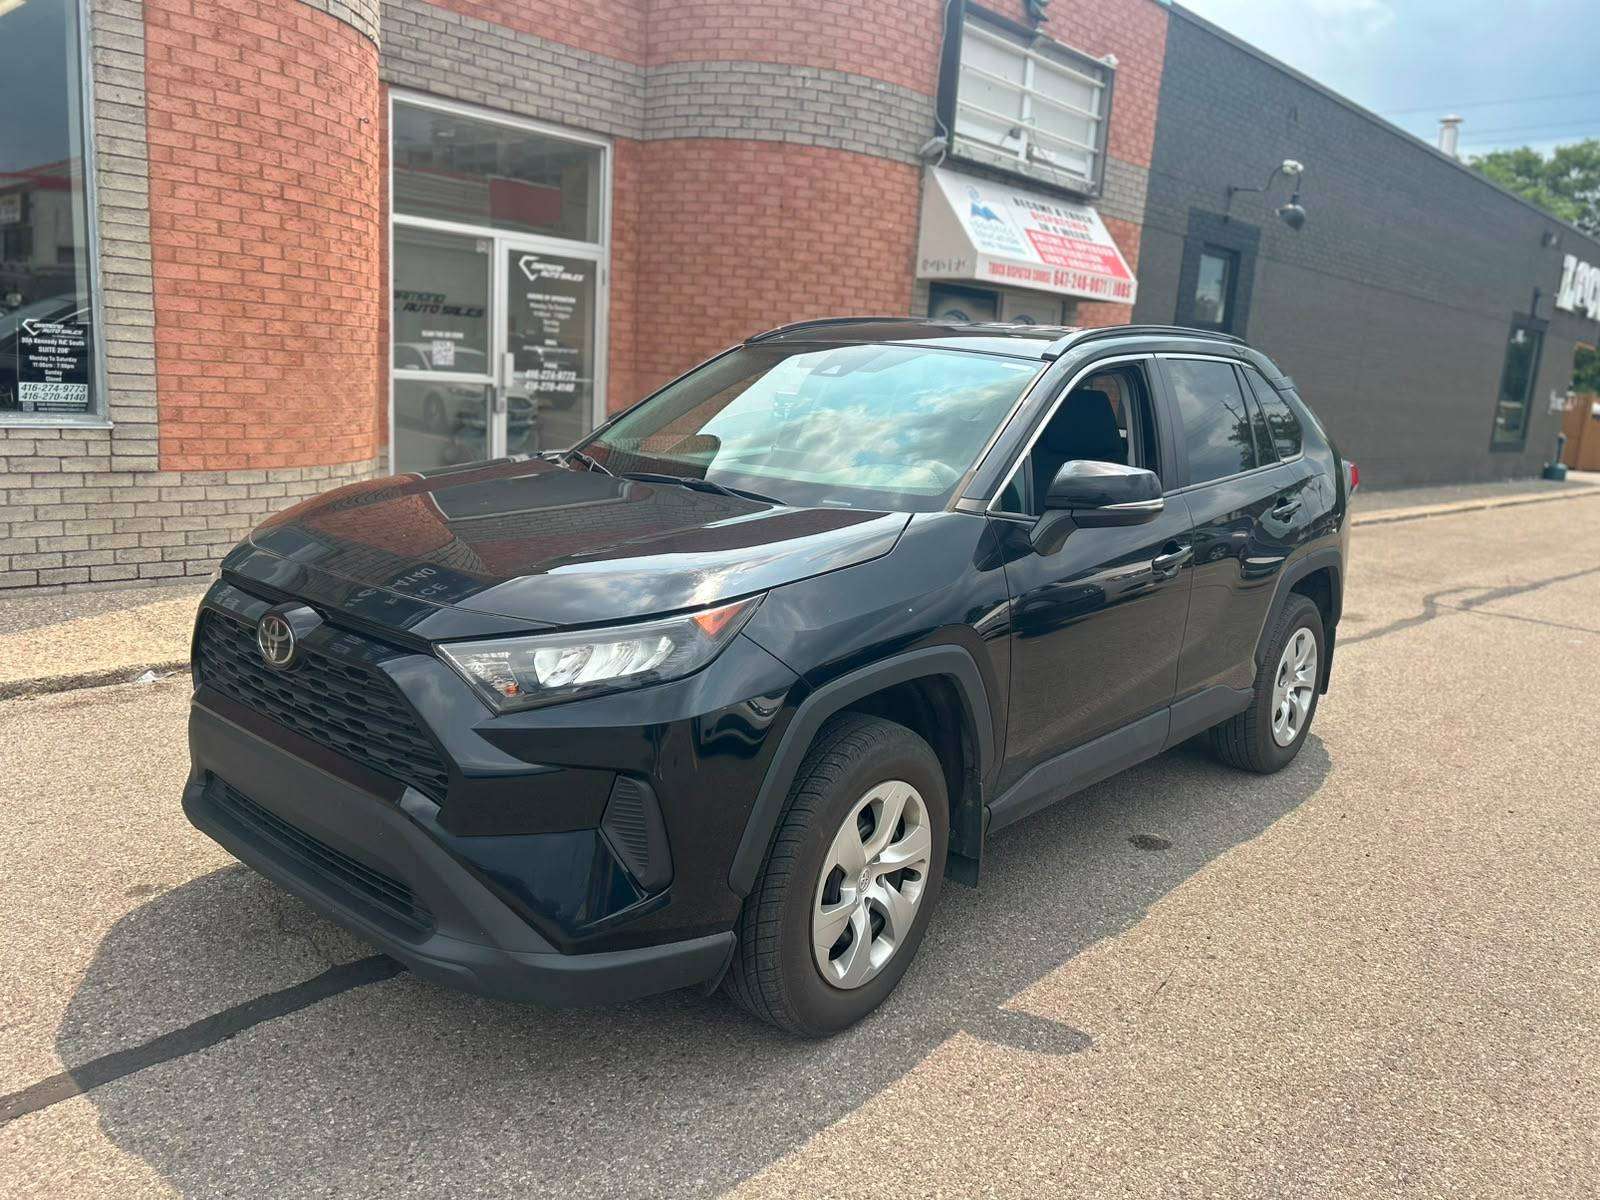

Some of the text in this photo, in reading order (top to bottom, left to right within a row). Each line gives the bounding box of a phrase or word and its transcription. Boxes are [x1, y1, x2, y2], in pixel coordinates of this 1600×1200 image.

[403, 302, 440, 314] AUTO
[20, 384, 86, 393] 416-274-9773
[21, 392, 86, 401] 416-270-4140
